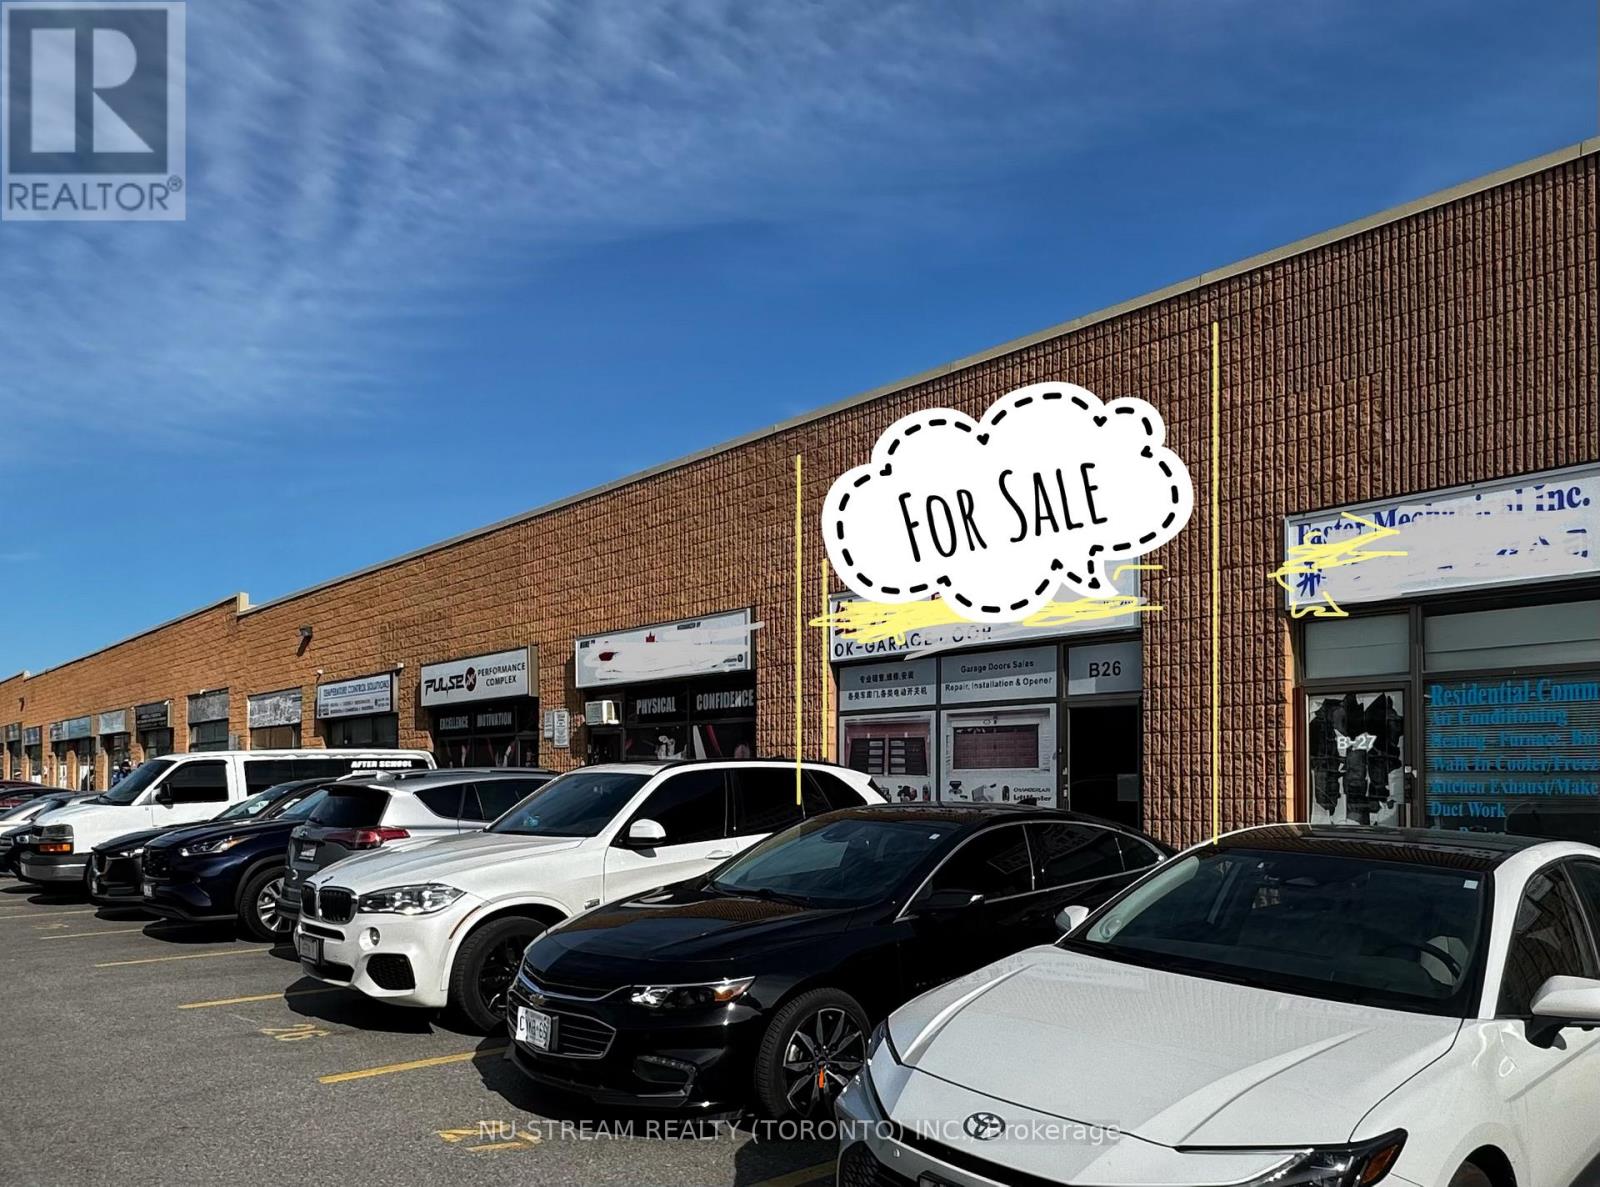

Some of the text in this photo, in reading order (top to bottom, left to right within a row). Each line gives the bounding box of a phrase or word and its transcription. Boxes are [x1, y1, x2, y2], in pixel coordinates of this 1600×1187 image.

[477, 662, 526, 676] PERFORMANCE
[960, 660, 1034, 674] Garage Doors Sales
[1088, 660, 1122, 679] B26
[424, 673, 465, 698] PULSE
[485, 675, 517, 687] COMPLEX
[971, 680, 1014, 690] Installation
[1022, 676, 1053, 687] Opener
[636, 689, 755, 715] PHYSICAL CONFIDENCE
[1337, 735, 1377, 749] B-27
[351, 760, 412, 769] AFTER SCHOOL
[1430, 801, 1506, 818] Duct Work
